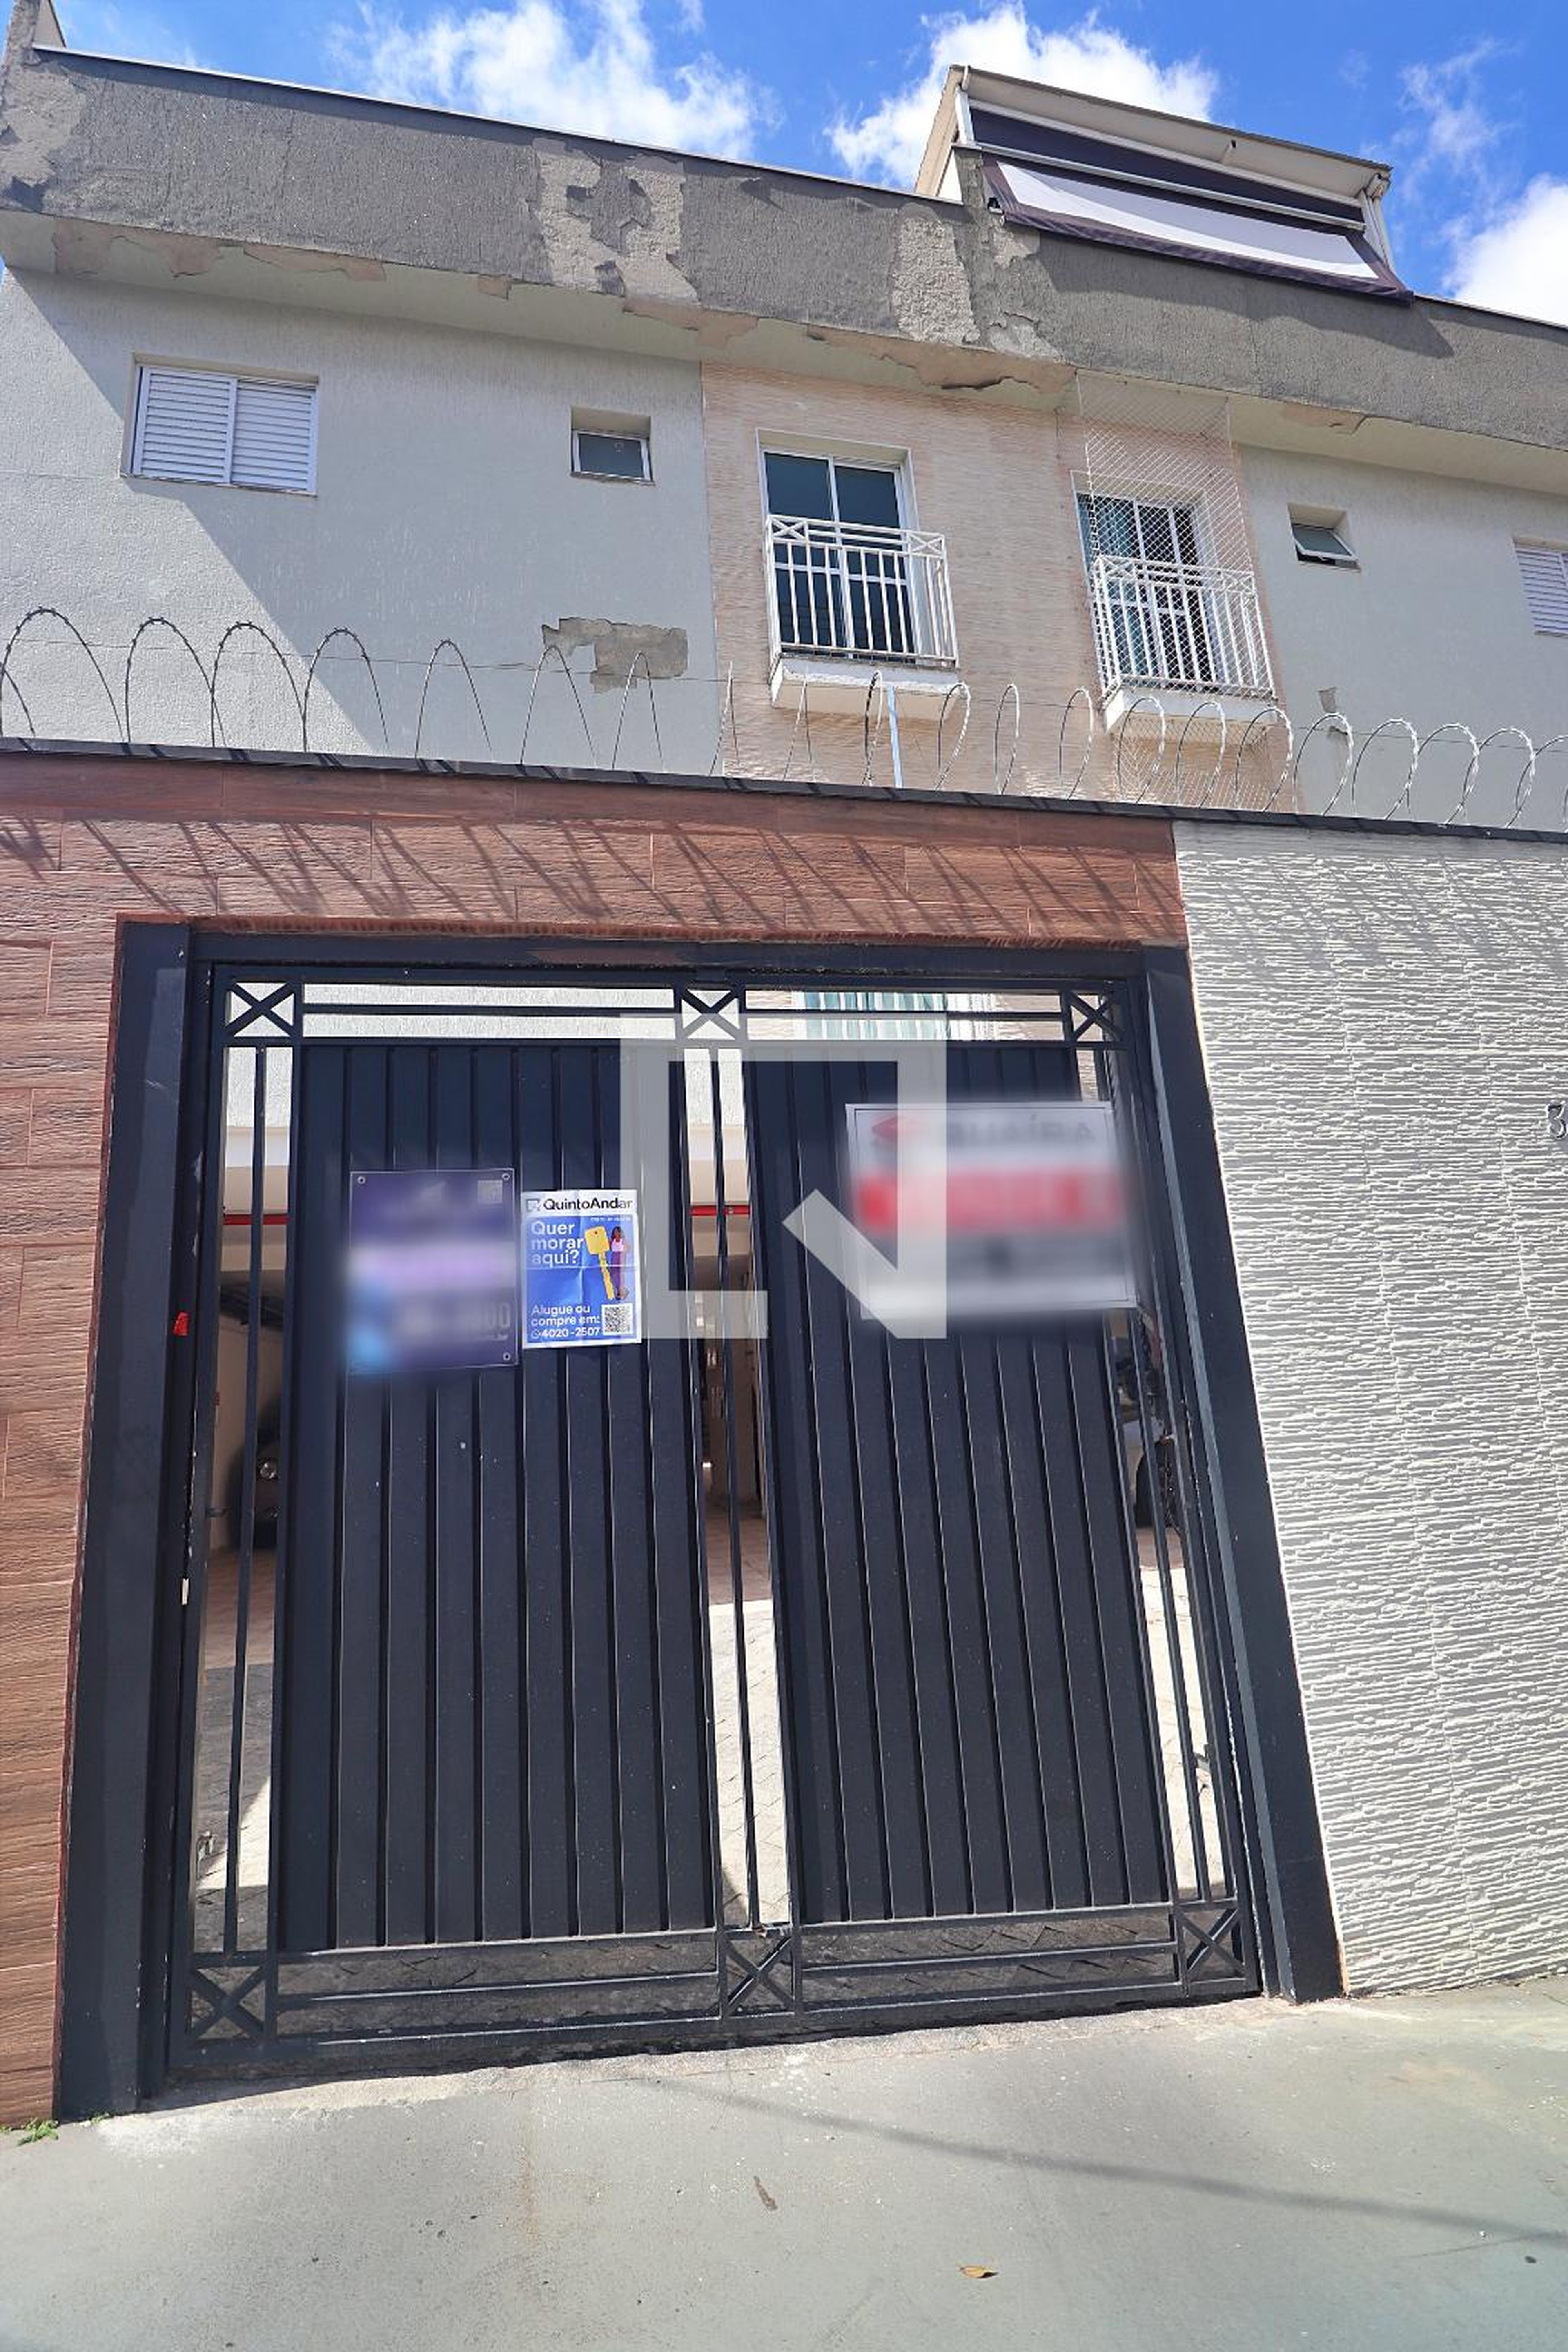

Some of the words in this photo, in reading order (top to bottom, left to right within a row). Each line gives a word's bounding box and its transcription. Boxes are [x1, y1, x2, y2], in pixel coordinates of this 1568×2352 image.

[543, 1197, 633, 1210] QuintoAndar
[532, 1221, 575, 1235] Quer
[532, 1238, 584, 1250] morar
[532, 1250, 579, 1268] aqui?
[531, 1304, 573, 1317] Alugue
[575, 1305, 590, 1314] ou
[531, 1316, 577, 1327] compre
